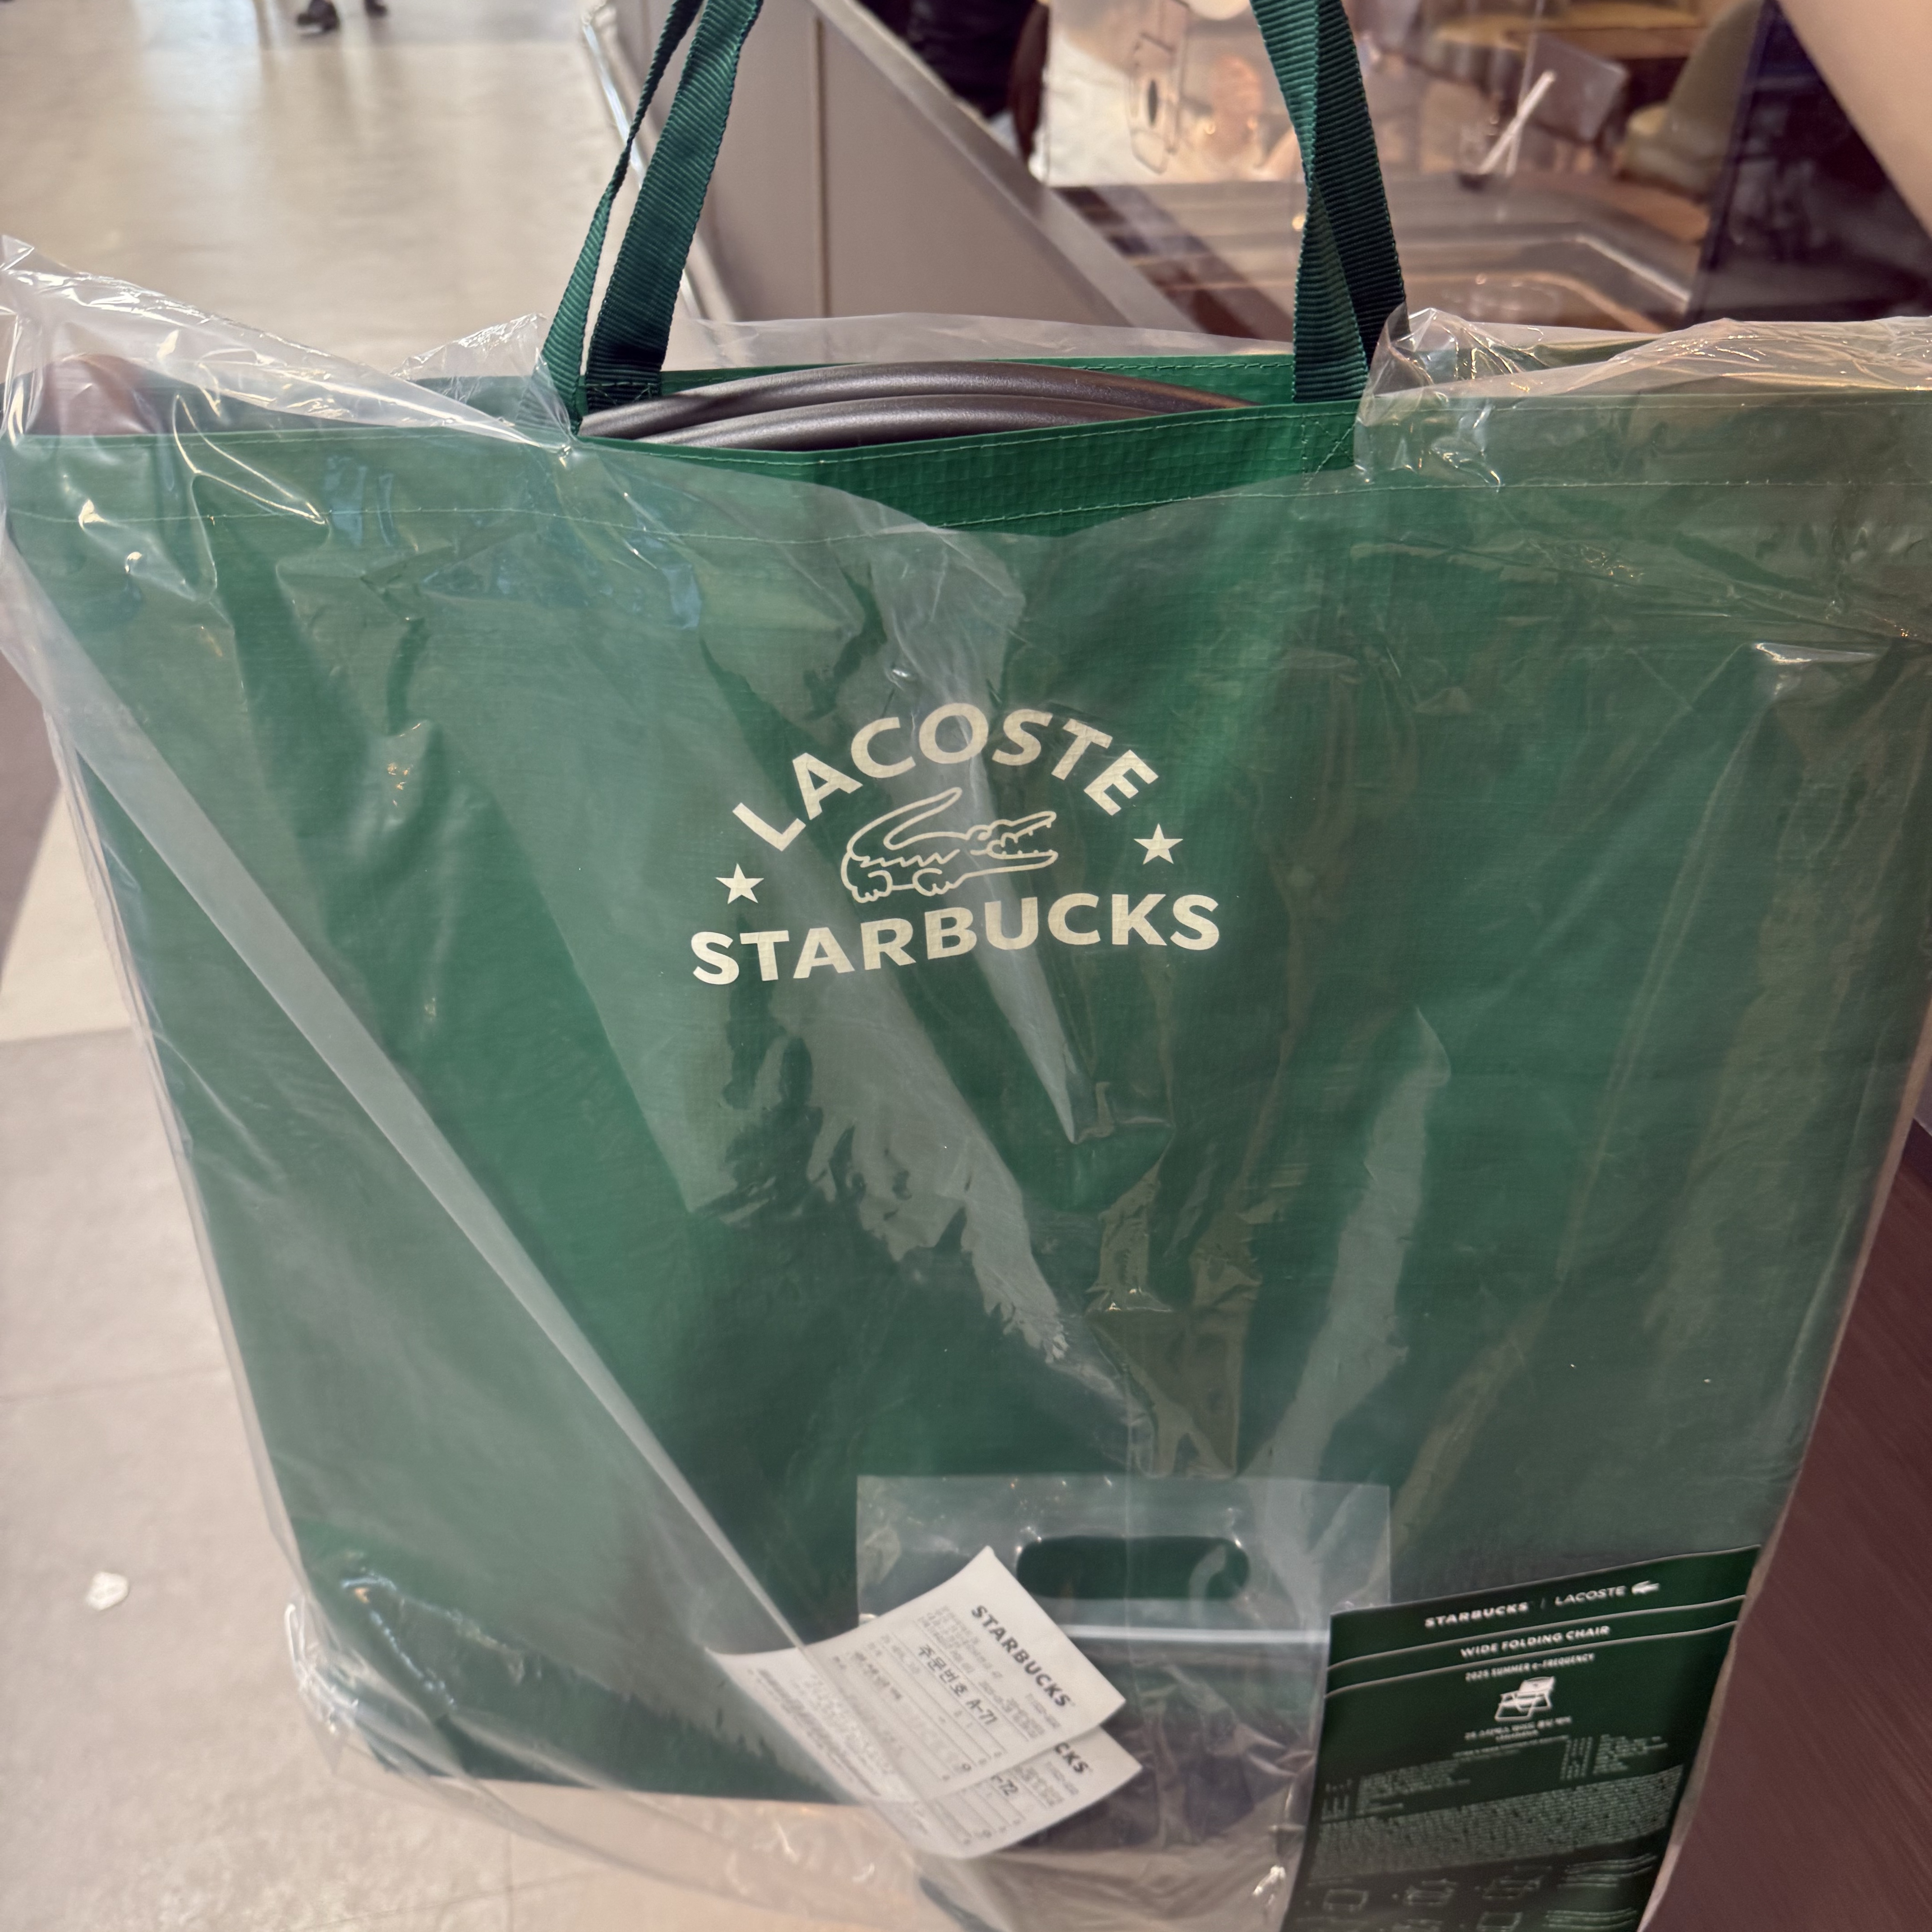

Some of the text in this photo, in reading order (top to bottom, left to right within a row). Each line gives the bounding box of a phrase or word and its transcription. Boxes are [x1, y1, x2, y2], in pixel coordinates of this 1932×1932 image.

[732, 702, 1159, 851] LACOSTE
[690, 892, 1220, 985] STARBUCKS
[1425, 1585, 1626, 1628] STARBUCKS LACOSTE
[1460, 1625, 1611, 1659] WIDE FOLDING CHAIR
[918, 1644, 968, 1697] 주문번호
[966, 1698, 998, 1725] A-71
[971, 1605, 1071, 1707] STARBUCKS
